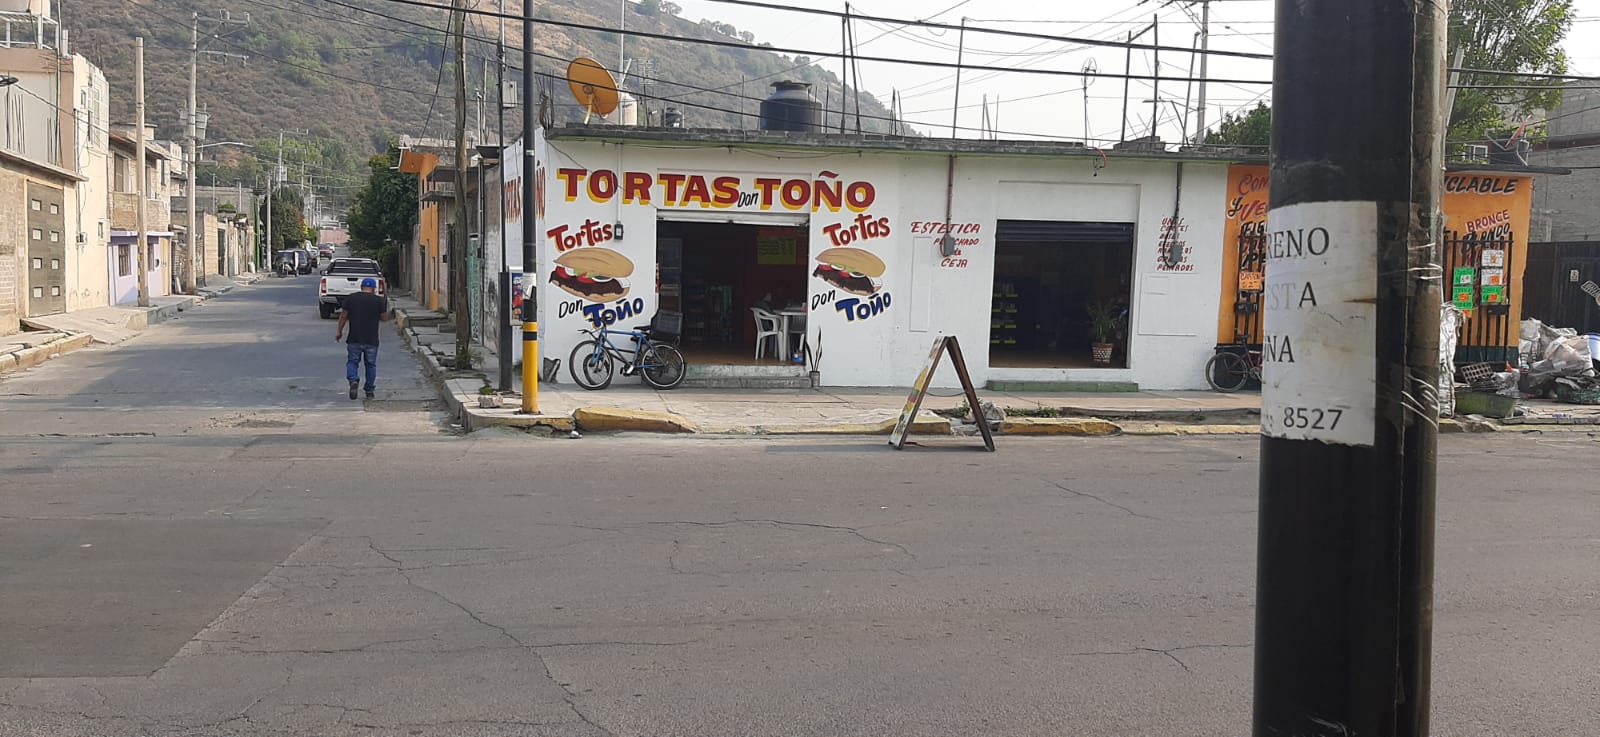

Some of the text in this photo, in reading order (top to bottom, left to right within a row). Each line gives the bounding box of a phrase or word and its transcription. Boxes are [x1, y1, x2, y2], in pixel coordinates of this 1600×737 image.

[557, 167, 876, 212] TORTAS Don TOÑO
[547, 219, 613, 251] Tortas
[823, 213, 891, 247] Tortas
[1466, 209, 1510, 233] BRONCE
[941, 258, 968, 268] CEJA
[558, 297, 644, 329] Don Toño
[811, 289, 892, 322] Don Toño
[1283, 406, 1343, 431] 8527
